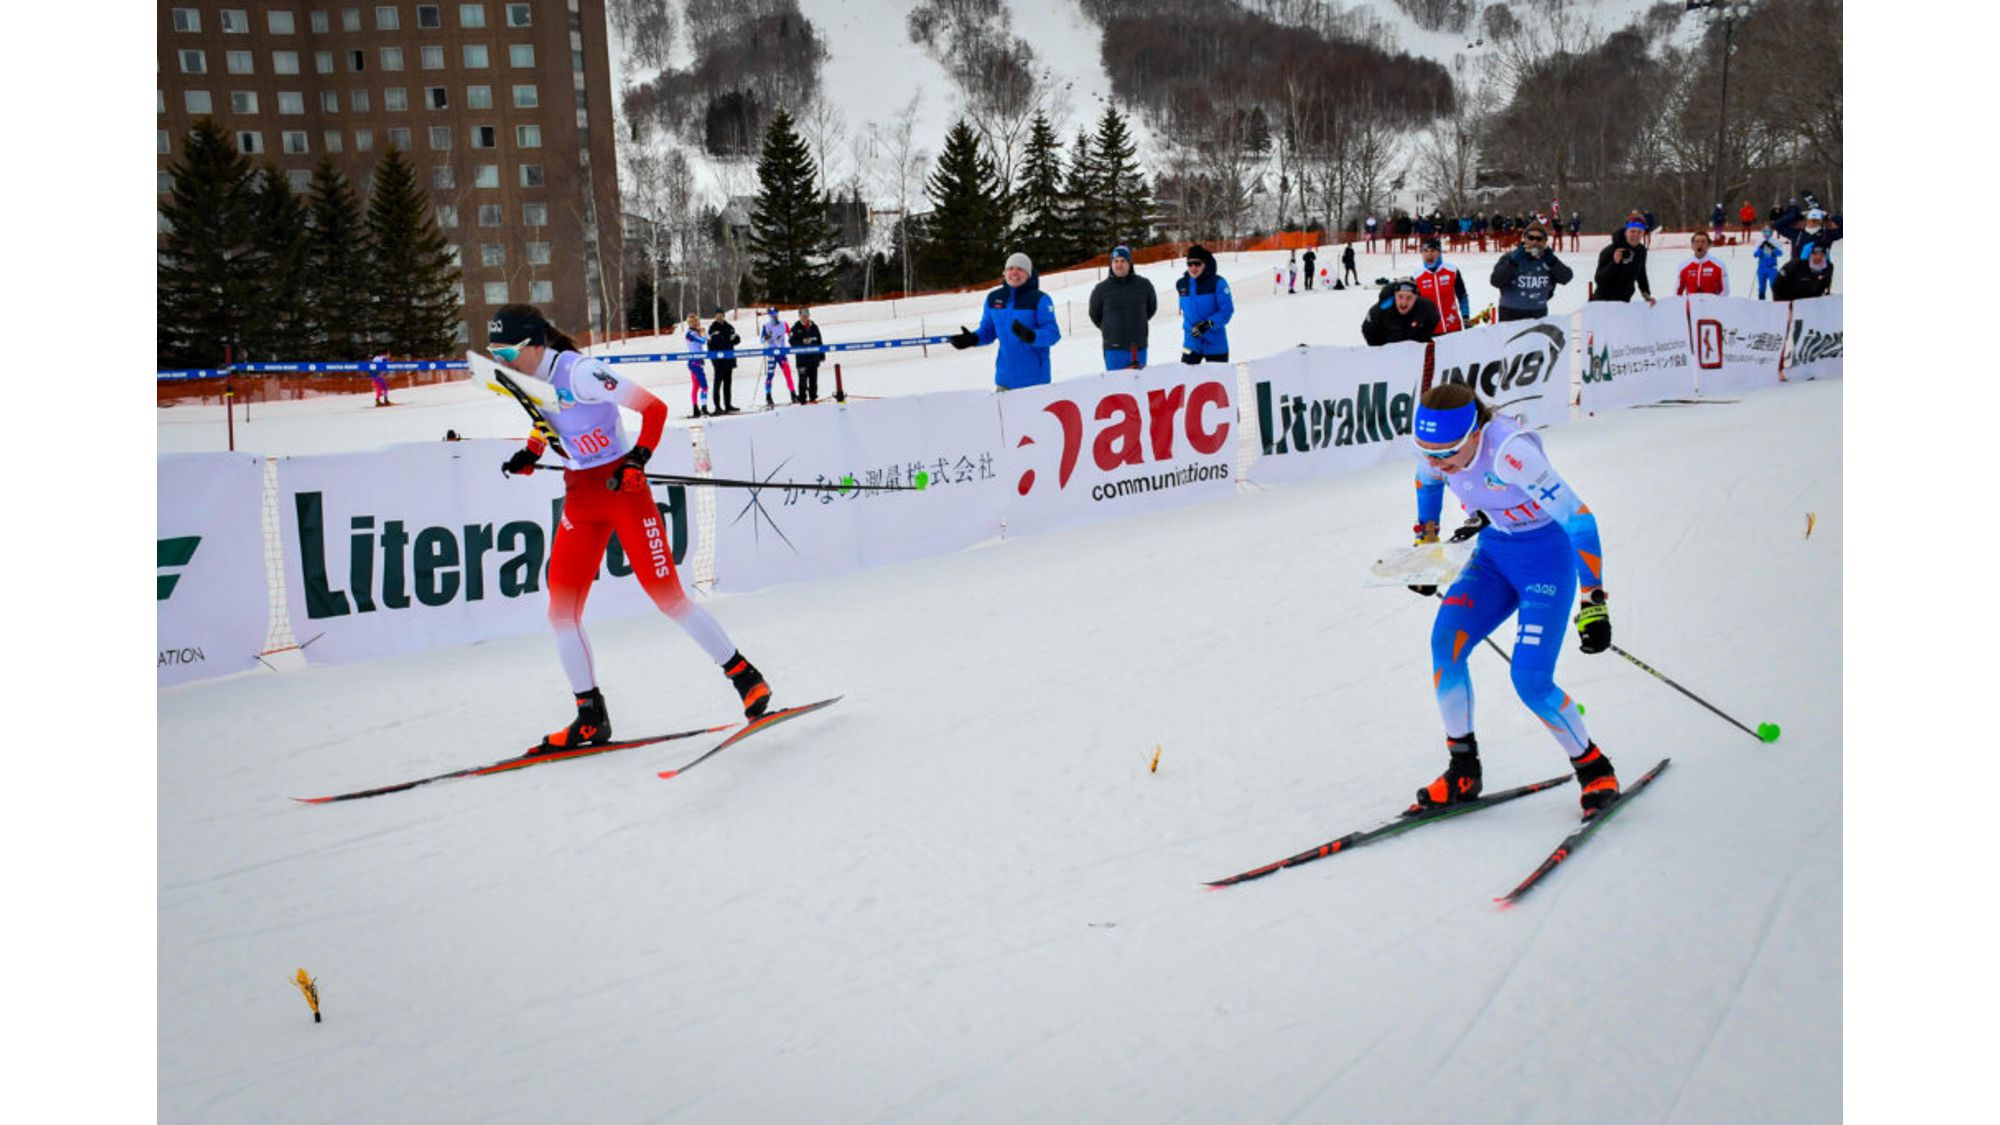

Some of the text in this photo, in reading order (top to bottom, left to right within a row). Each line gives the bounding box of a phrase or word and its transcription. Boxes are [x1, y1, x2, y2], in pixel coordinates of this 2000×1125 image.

[1518, 275, 1549, 289] STAFF
[573, 428, 610, 456] 106
[1092, 381, 1230, 471] arc
[1256, 379, 1417, 456] LiteraMe
[294, 485, 687, 620] Literad
[643, 516, 670, 578] SUISSE
